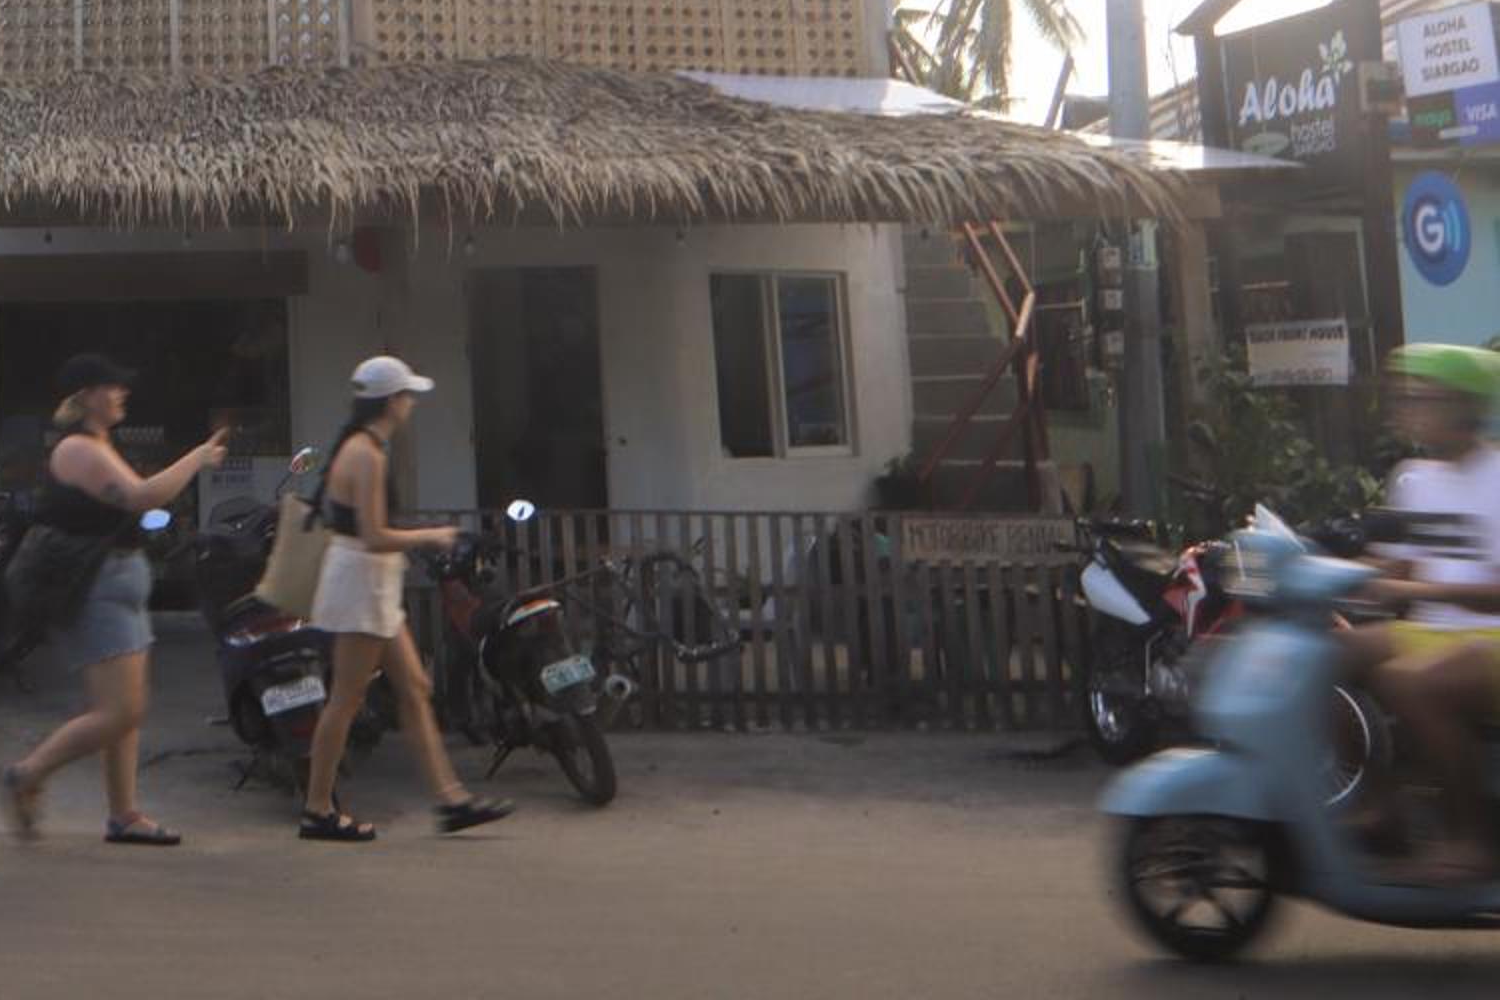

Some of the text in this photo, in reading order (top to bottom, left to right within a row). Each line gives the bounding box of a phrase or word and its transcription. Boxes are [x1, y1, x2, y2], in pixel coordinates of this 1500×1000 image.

[1423, 15, 1467, 38] ALOHA
[1424, 37, 1472, 60] HOSTEL
[1421, 57, 1480, 82] SIARGAO
[1238, 67, 1335, 126] Aloha
[1466, 103, 1498, 122] VISA
